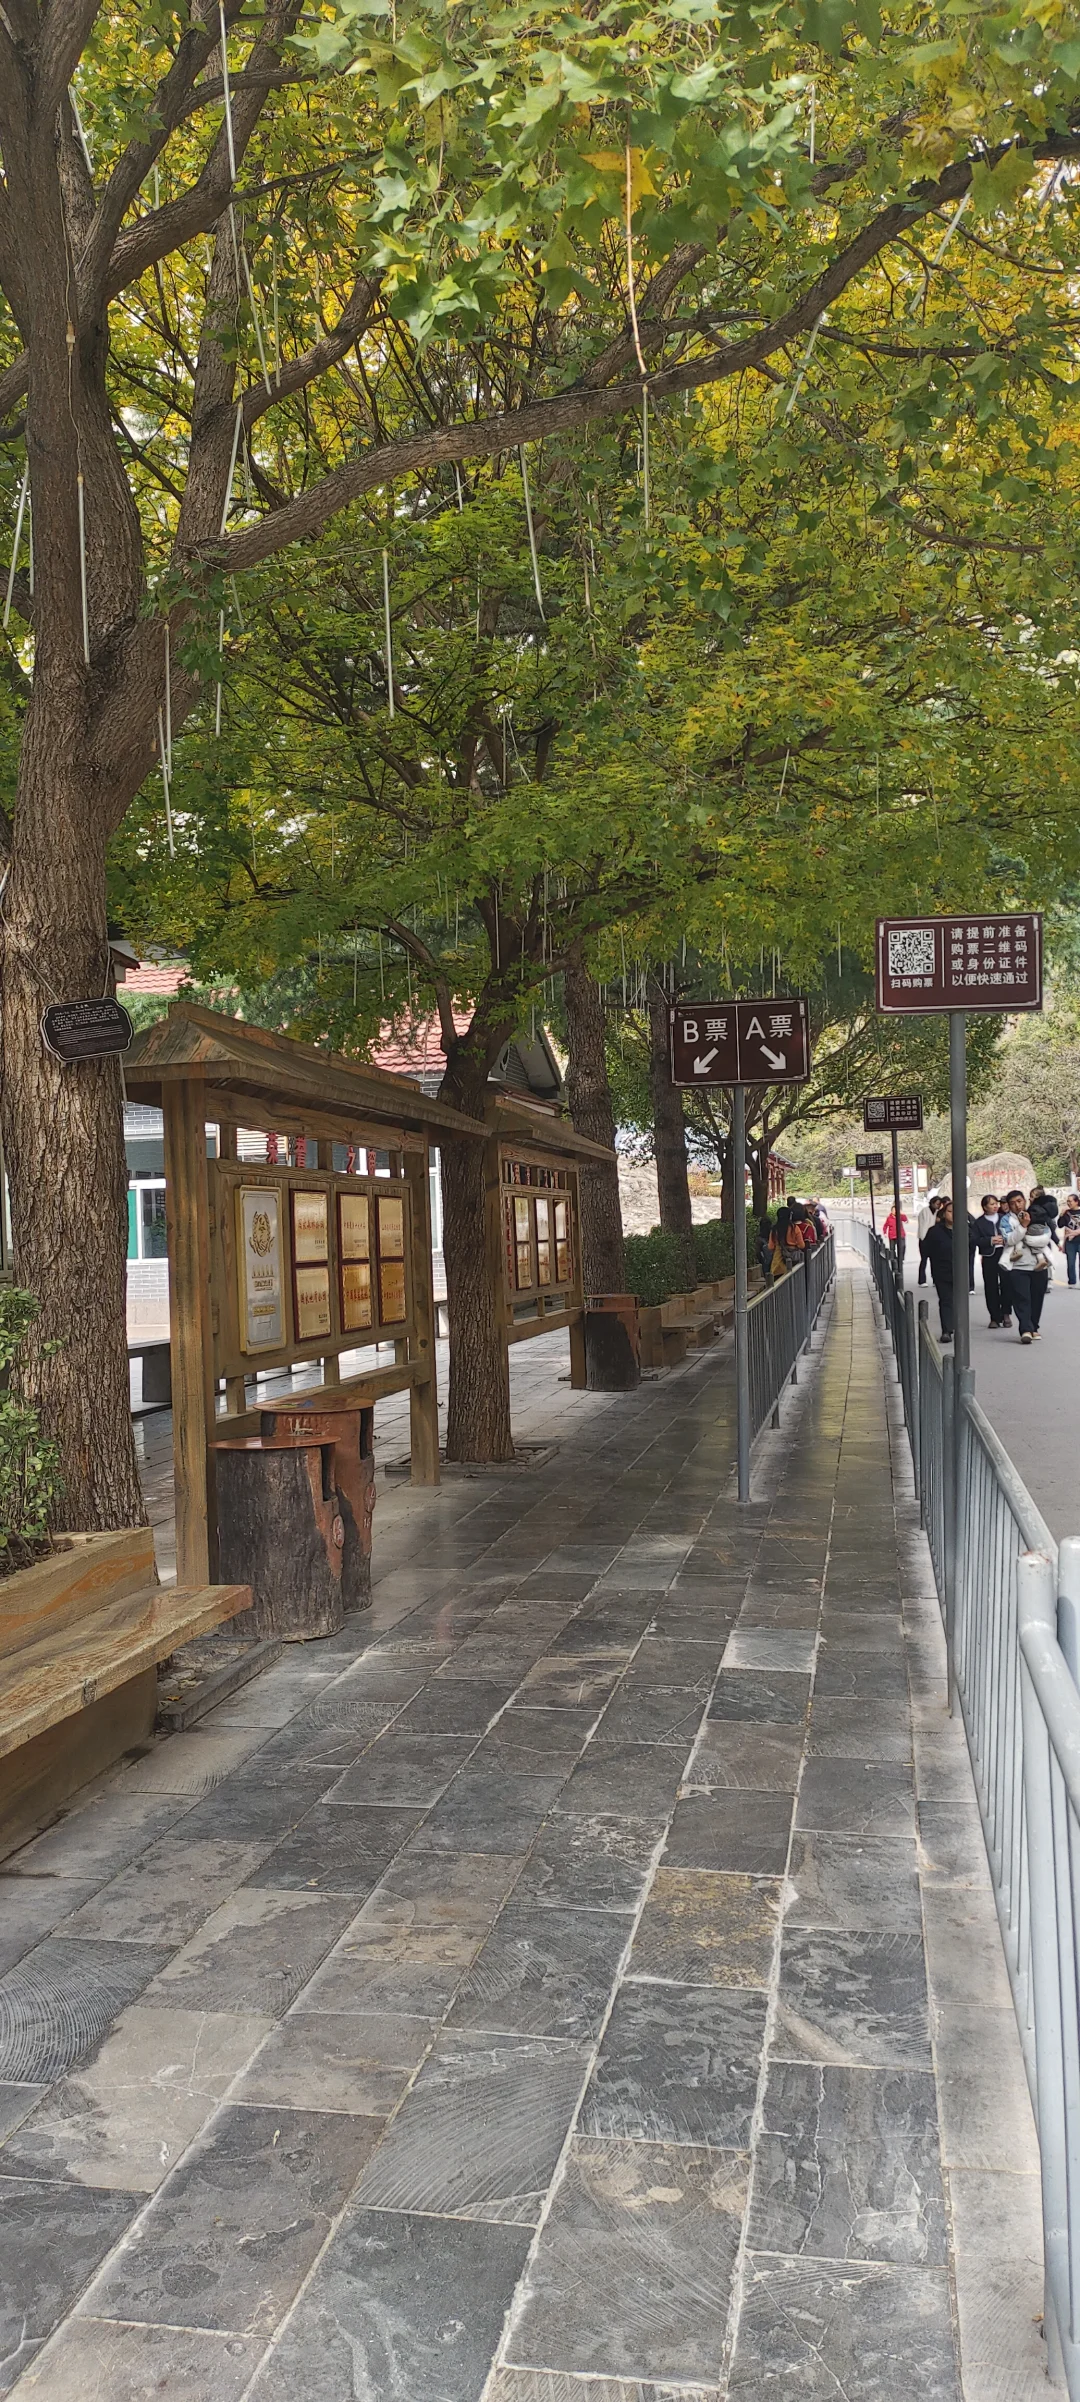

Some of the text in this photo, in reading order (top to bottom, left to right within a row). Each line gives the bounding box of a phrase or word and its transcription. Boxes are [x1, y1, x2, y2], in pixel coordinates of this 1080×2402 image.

[950, 924, 1028, 940] 请提前准备
[950, 940, 1028, 956] 购票二维码
[950, 955, 1029, 971] 或身份证件
[890, 977, 934, 989] 扫码购票
[951, 971, 1029, 986] 以便快速通过
[683, 1018, 729, 1044] B票
[745, 1014, 793, 1040] A票
